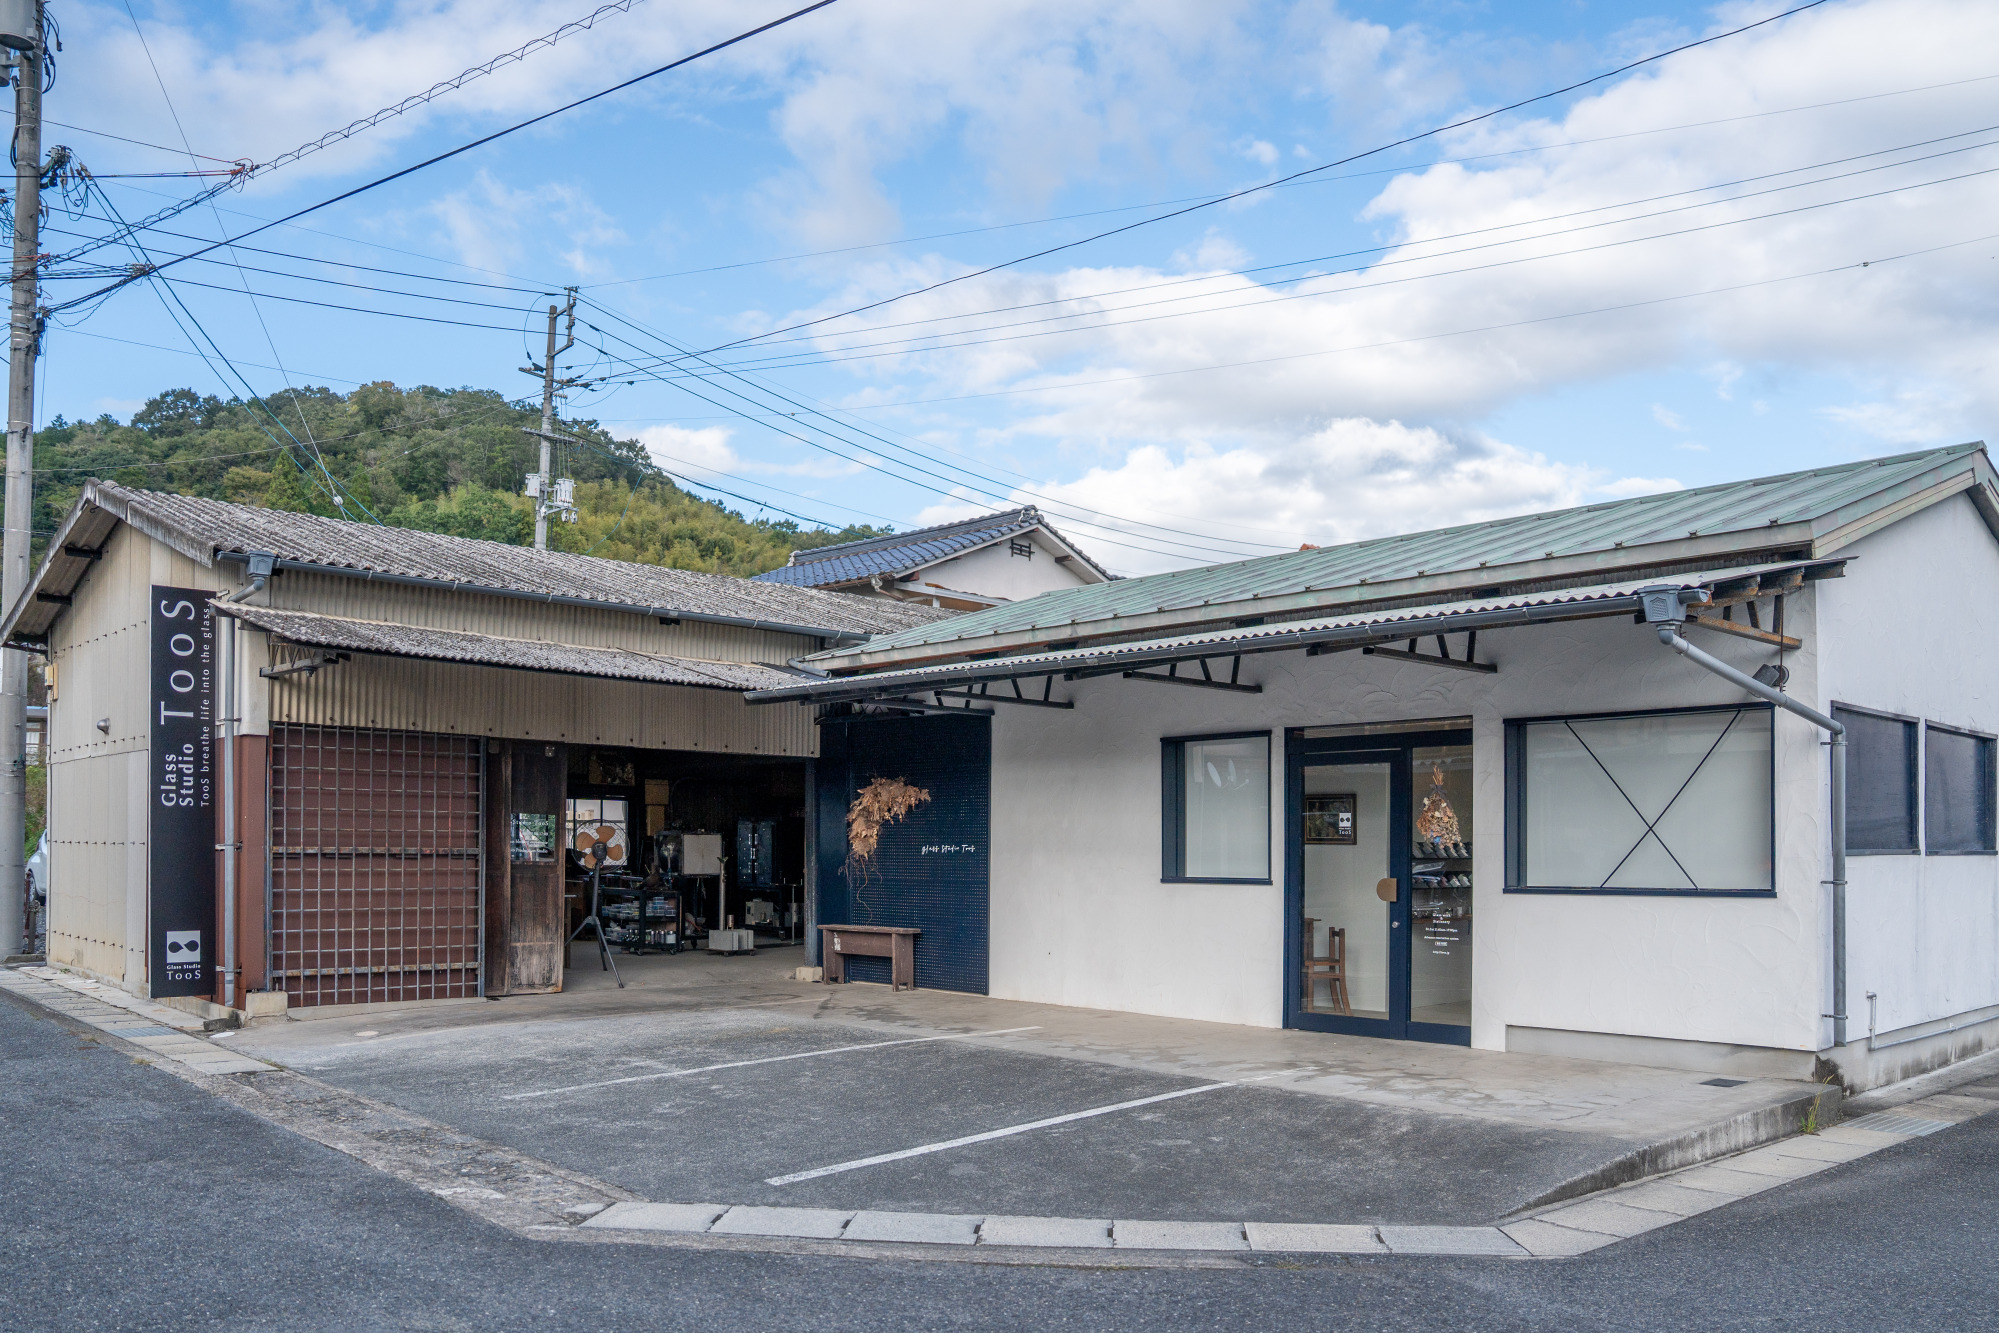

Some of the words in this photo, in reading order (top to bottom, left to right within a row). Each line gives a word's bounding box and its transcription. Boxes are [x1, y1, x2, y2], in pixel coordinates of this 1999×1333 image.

[160, 599, 195, 725] TooS
[200, 644, 210, 663] the
[200, 669, 210, 693] into
[200, 699, 210, 720] life
[200, 726, 210, 772] breathe
[160, 754, 177, 807] Glass
[178, 743, 194, 807] Studio
[200, 778, 210, 807] TooS
[166, 969, 201, 980] TooS
